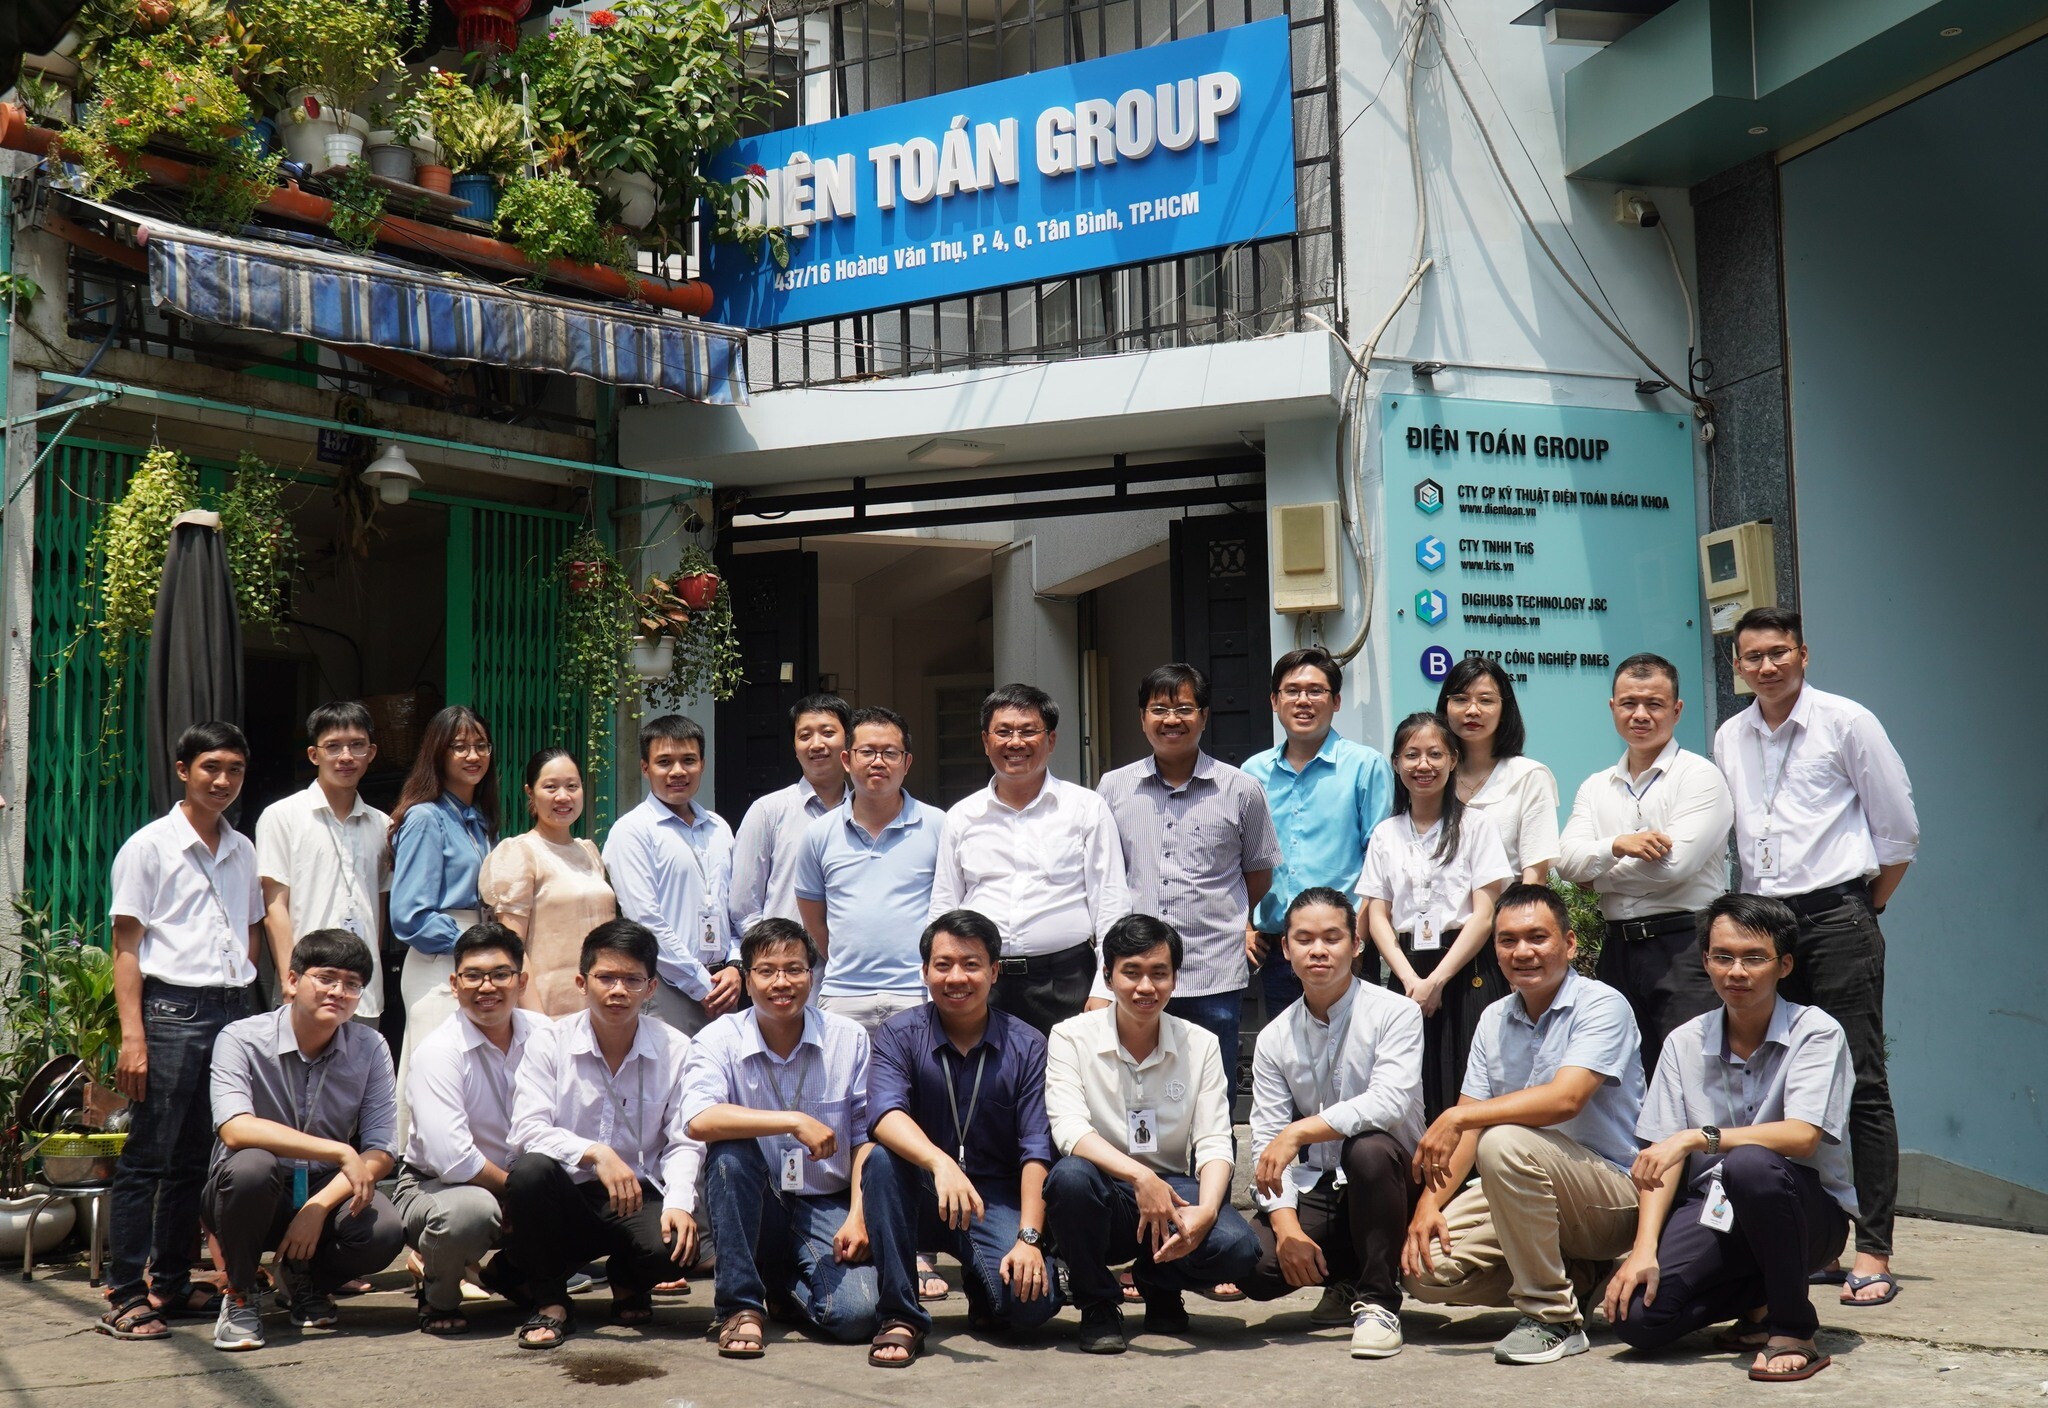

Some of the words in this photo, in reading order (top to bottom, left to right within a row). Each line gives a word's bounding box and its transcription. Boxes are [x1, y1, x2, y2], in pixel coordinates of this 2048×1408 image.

[868, 114, 1019, 210] TOÁN
[1036, 71, 1241, 177] GROUP
[774, 263, 830, 291] 437/16
[835, 255, 888, 281] Hoàng
[894, 247, 925, 270] Văn
[931, 240, 967, 263] Thụ,
[973, 234, 987, 255] P.
[992, 230, 1009, 252] 4,
[1014, 225, 1032, 248] Q.
[1037, 219, 1070, 243] Tân
[1076, 208, 1123, 236] Bình,
[1129, 191, 1199, 225] TP.HCM
[1406, 424, 1459, 456] ĐIỆN
[1466, 428, 1526, 456] TOÁN
[1534, 435, 1609, 461] GROUP
[1458, 484, 1478, 498] CTY
[1482, 486, 1495, 499] CP
[1498, 485, 1512, 500] KỸ
[1515, 487, 1550, 505] THUẬT
[1552, 489, 1577, 506] ĐIỆN
[1580, 490, 1607, 506] TOÁN
[1610, 491, 1638, 507] BÁCH
[1641, 495, 1669, 509] KHOA
[1459, 503, 1536, 516] www.dientoan.vn
[1459, 539, 1479, 552] CTY
[1482, 540, 1511, 553] TNHH
[1514, 541, 1534, 555] TriS
[1461, 560, 1514, 571] www.tris.vn
[1462, 593, 1513, 607] DIGIHUBS
[1516, 595, 1585, 610] TECHNOLOGY
[1588, 598, 1607, 611] JSC
[1505, 649, 1535, 664] CÔNG
[1538, 650, 1577, 668] NGHIỆP
[1580, 653, 1610, 667] BMES
